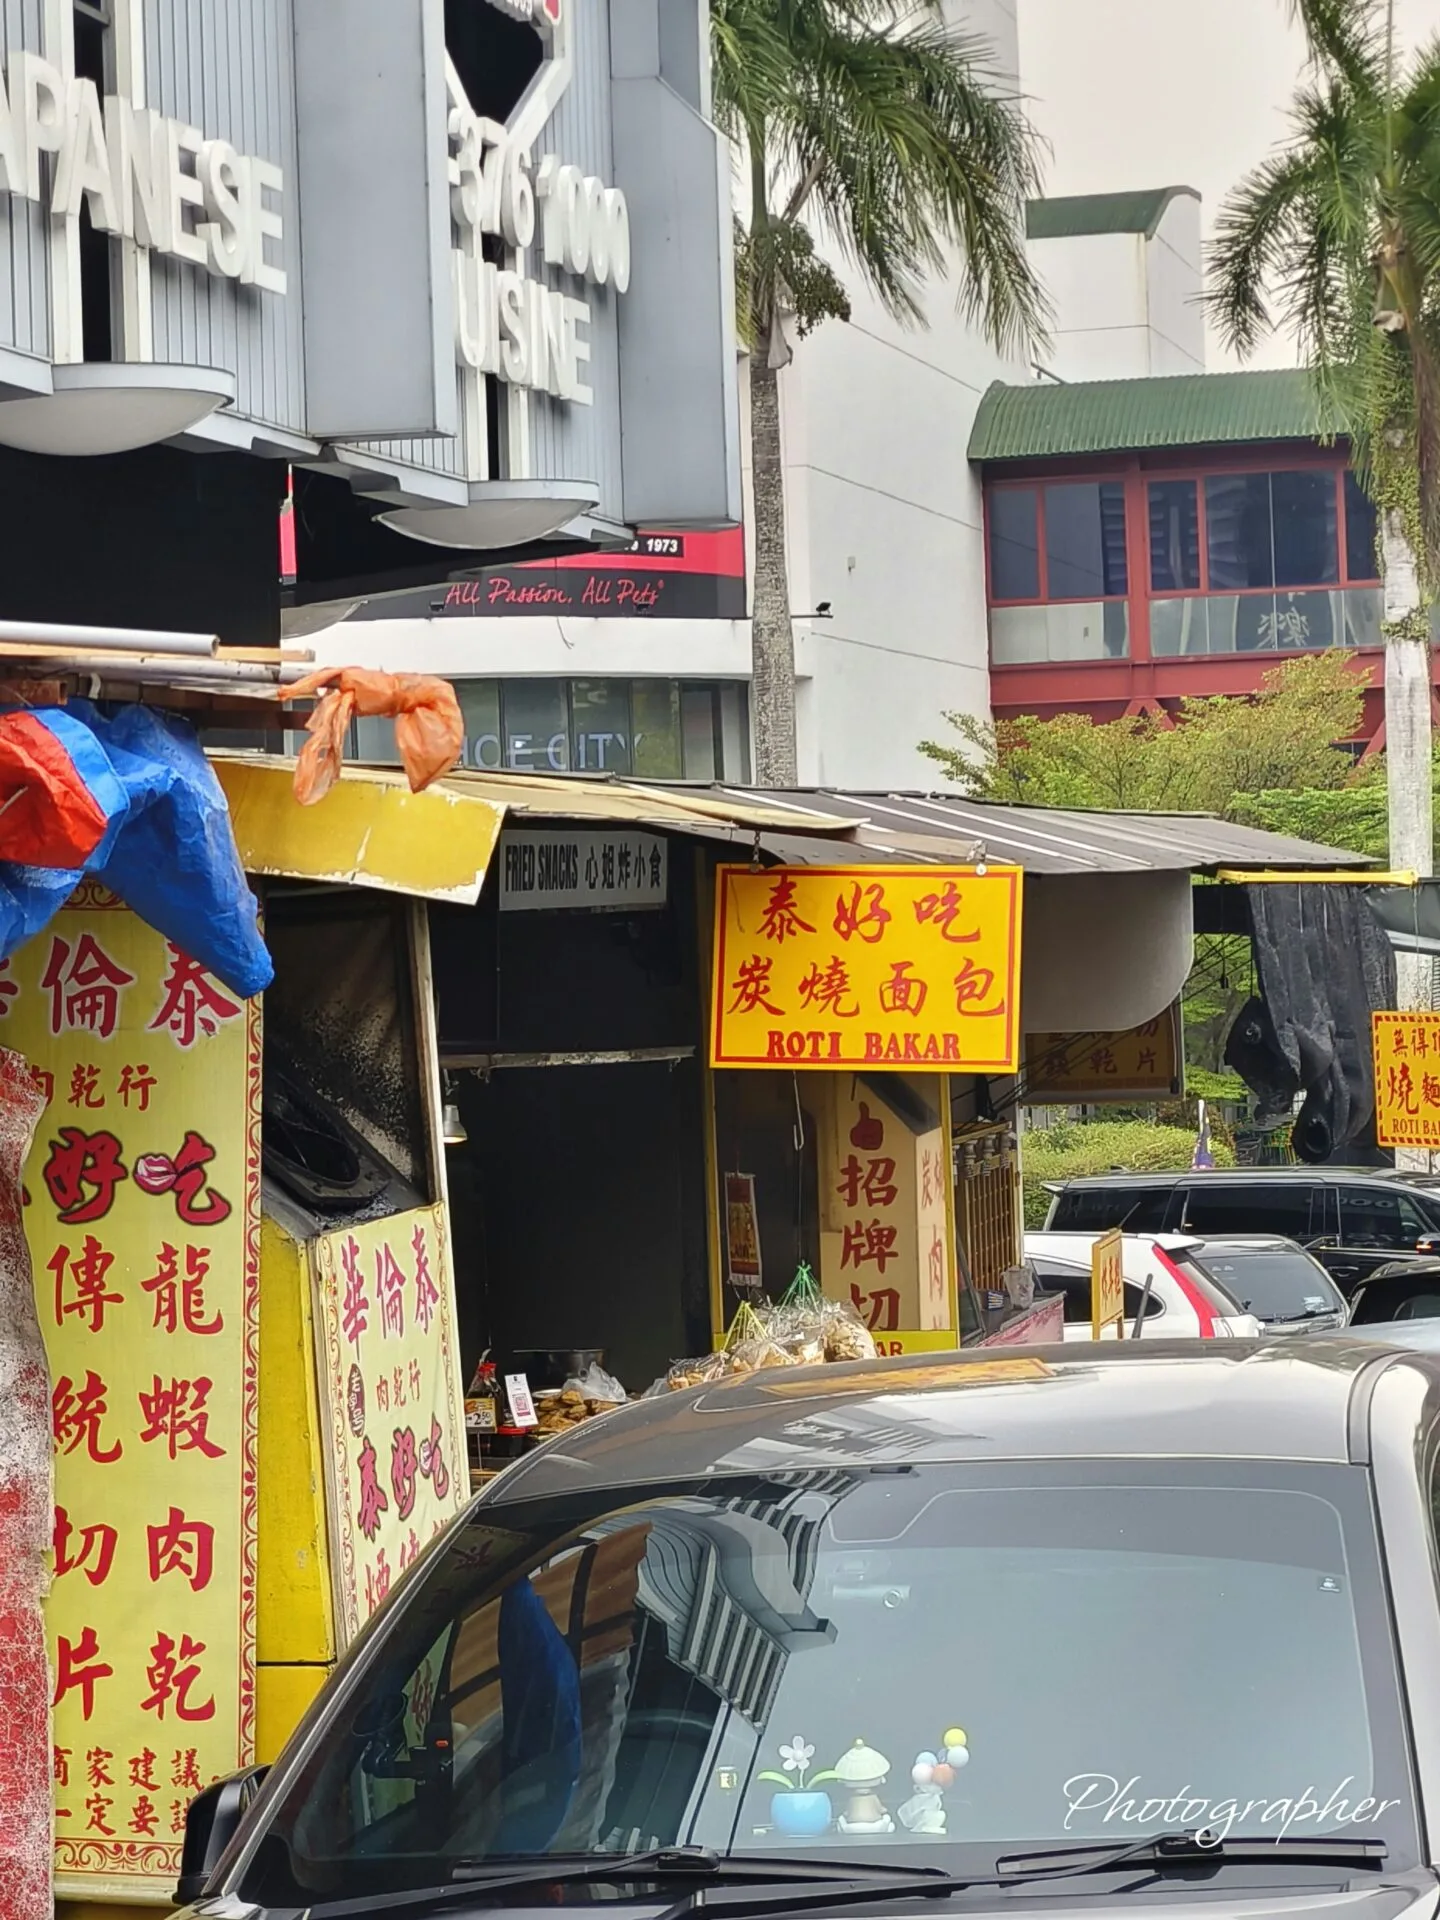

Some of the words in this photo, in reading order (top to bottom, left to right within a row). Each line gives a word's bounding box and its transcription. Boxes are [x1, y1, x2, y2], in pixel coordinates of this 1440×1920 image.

[452, 248, 593, 406] UISINE
[646, 537, 679, 553] 1973
[446, 581, 480, 605] All
[582, 576, 611, 605] All
[505, 843, 536, 892] FRIED
[538, 844, 579, 891] SNACKS
[756, 875, 981, 944] 泰好吃
[726, 953, 1005, 1018] 炭燒面包
[767, 1030, 843, 1059] ROTI
[864, 1032, 961, 1060] BAKAR
[1392, 1118, 1419, 1135] ROTI
[1423, 1120, 1440, 1136] BA
[22, 1126, 232, 1226] 好吃
